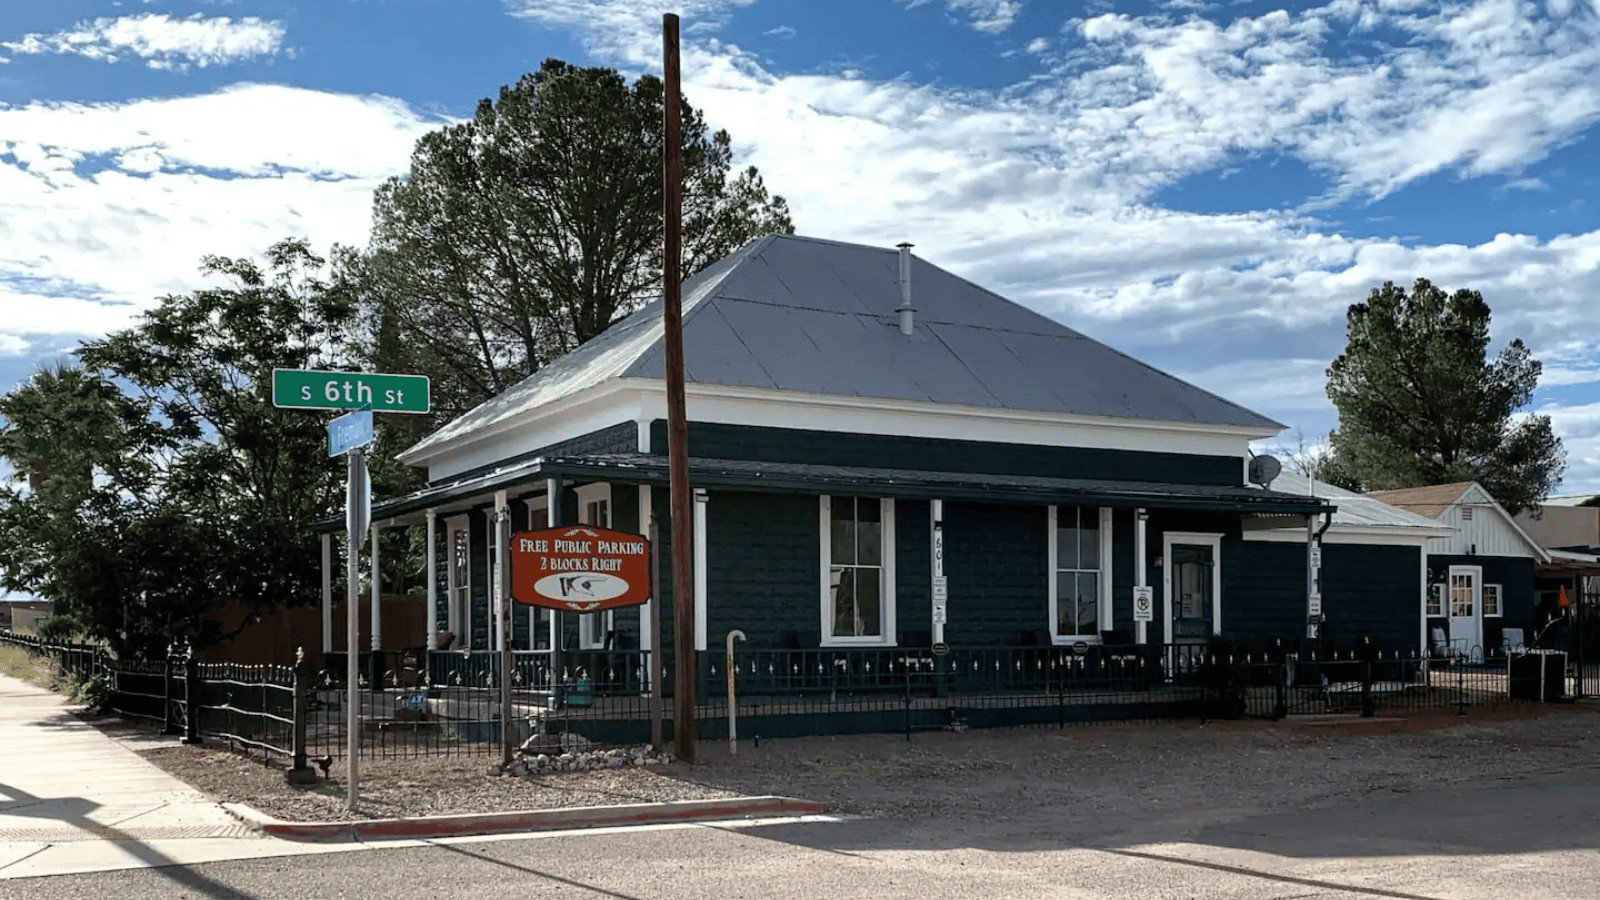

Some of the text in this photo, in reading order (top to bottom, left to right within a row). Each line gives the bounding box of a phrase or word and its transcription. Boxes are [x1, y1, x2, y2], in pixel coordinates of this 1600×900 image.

[301, 380, 403, 404] S 6th St
[520, 539, 643, 554] FREE PUBLIC PARKING
[541, 557, 622, 571] 2 BLOCKS RIGHT
